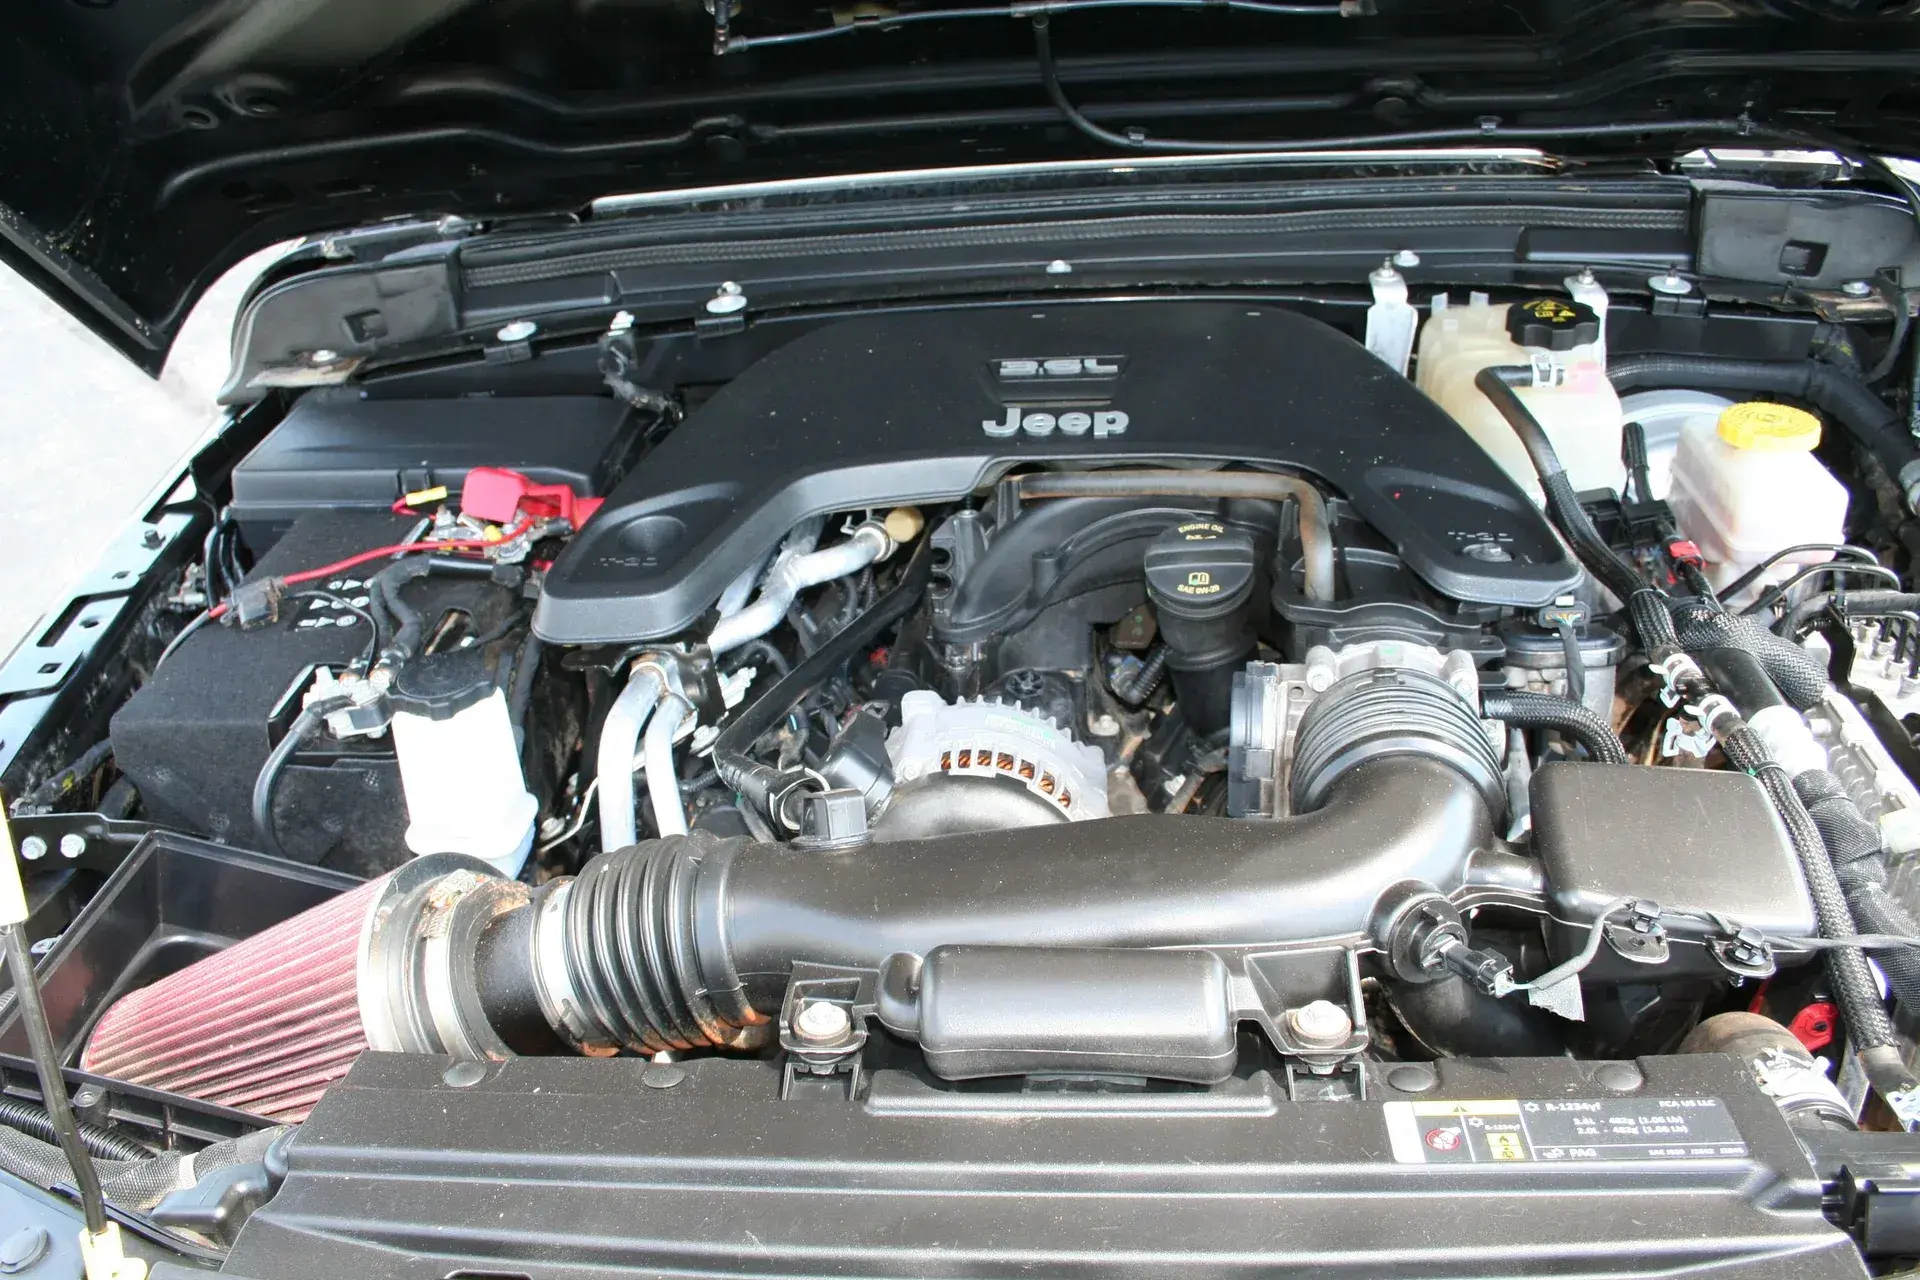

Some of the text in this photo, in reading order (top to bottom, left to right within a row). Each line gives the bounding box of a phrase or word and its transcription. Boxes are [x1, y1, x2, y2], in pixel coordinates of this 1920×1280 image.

[982, 407, 1129, 438] Jeep
[1178, 523, 1224, 533] ENGINE OIL
[1177, 584, 1194, 594] SAE
[1569, 1147, 1597, 1158] PAG
